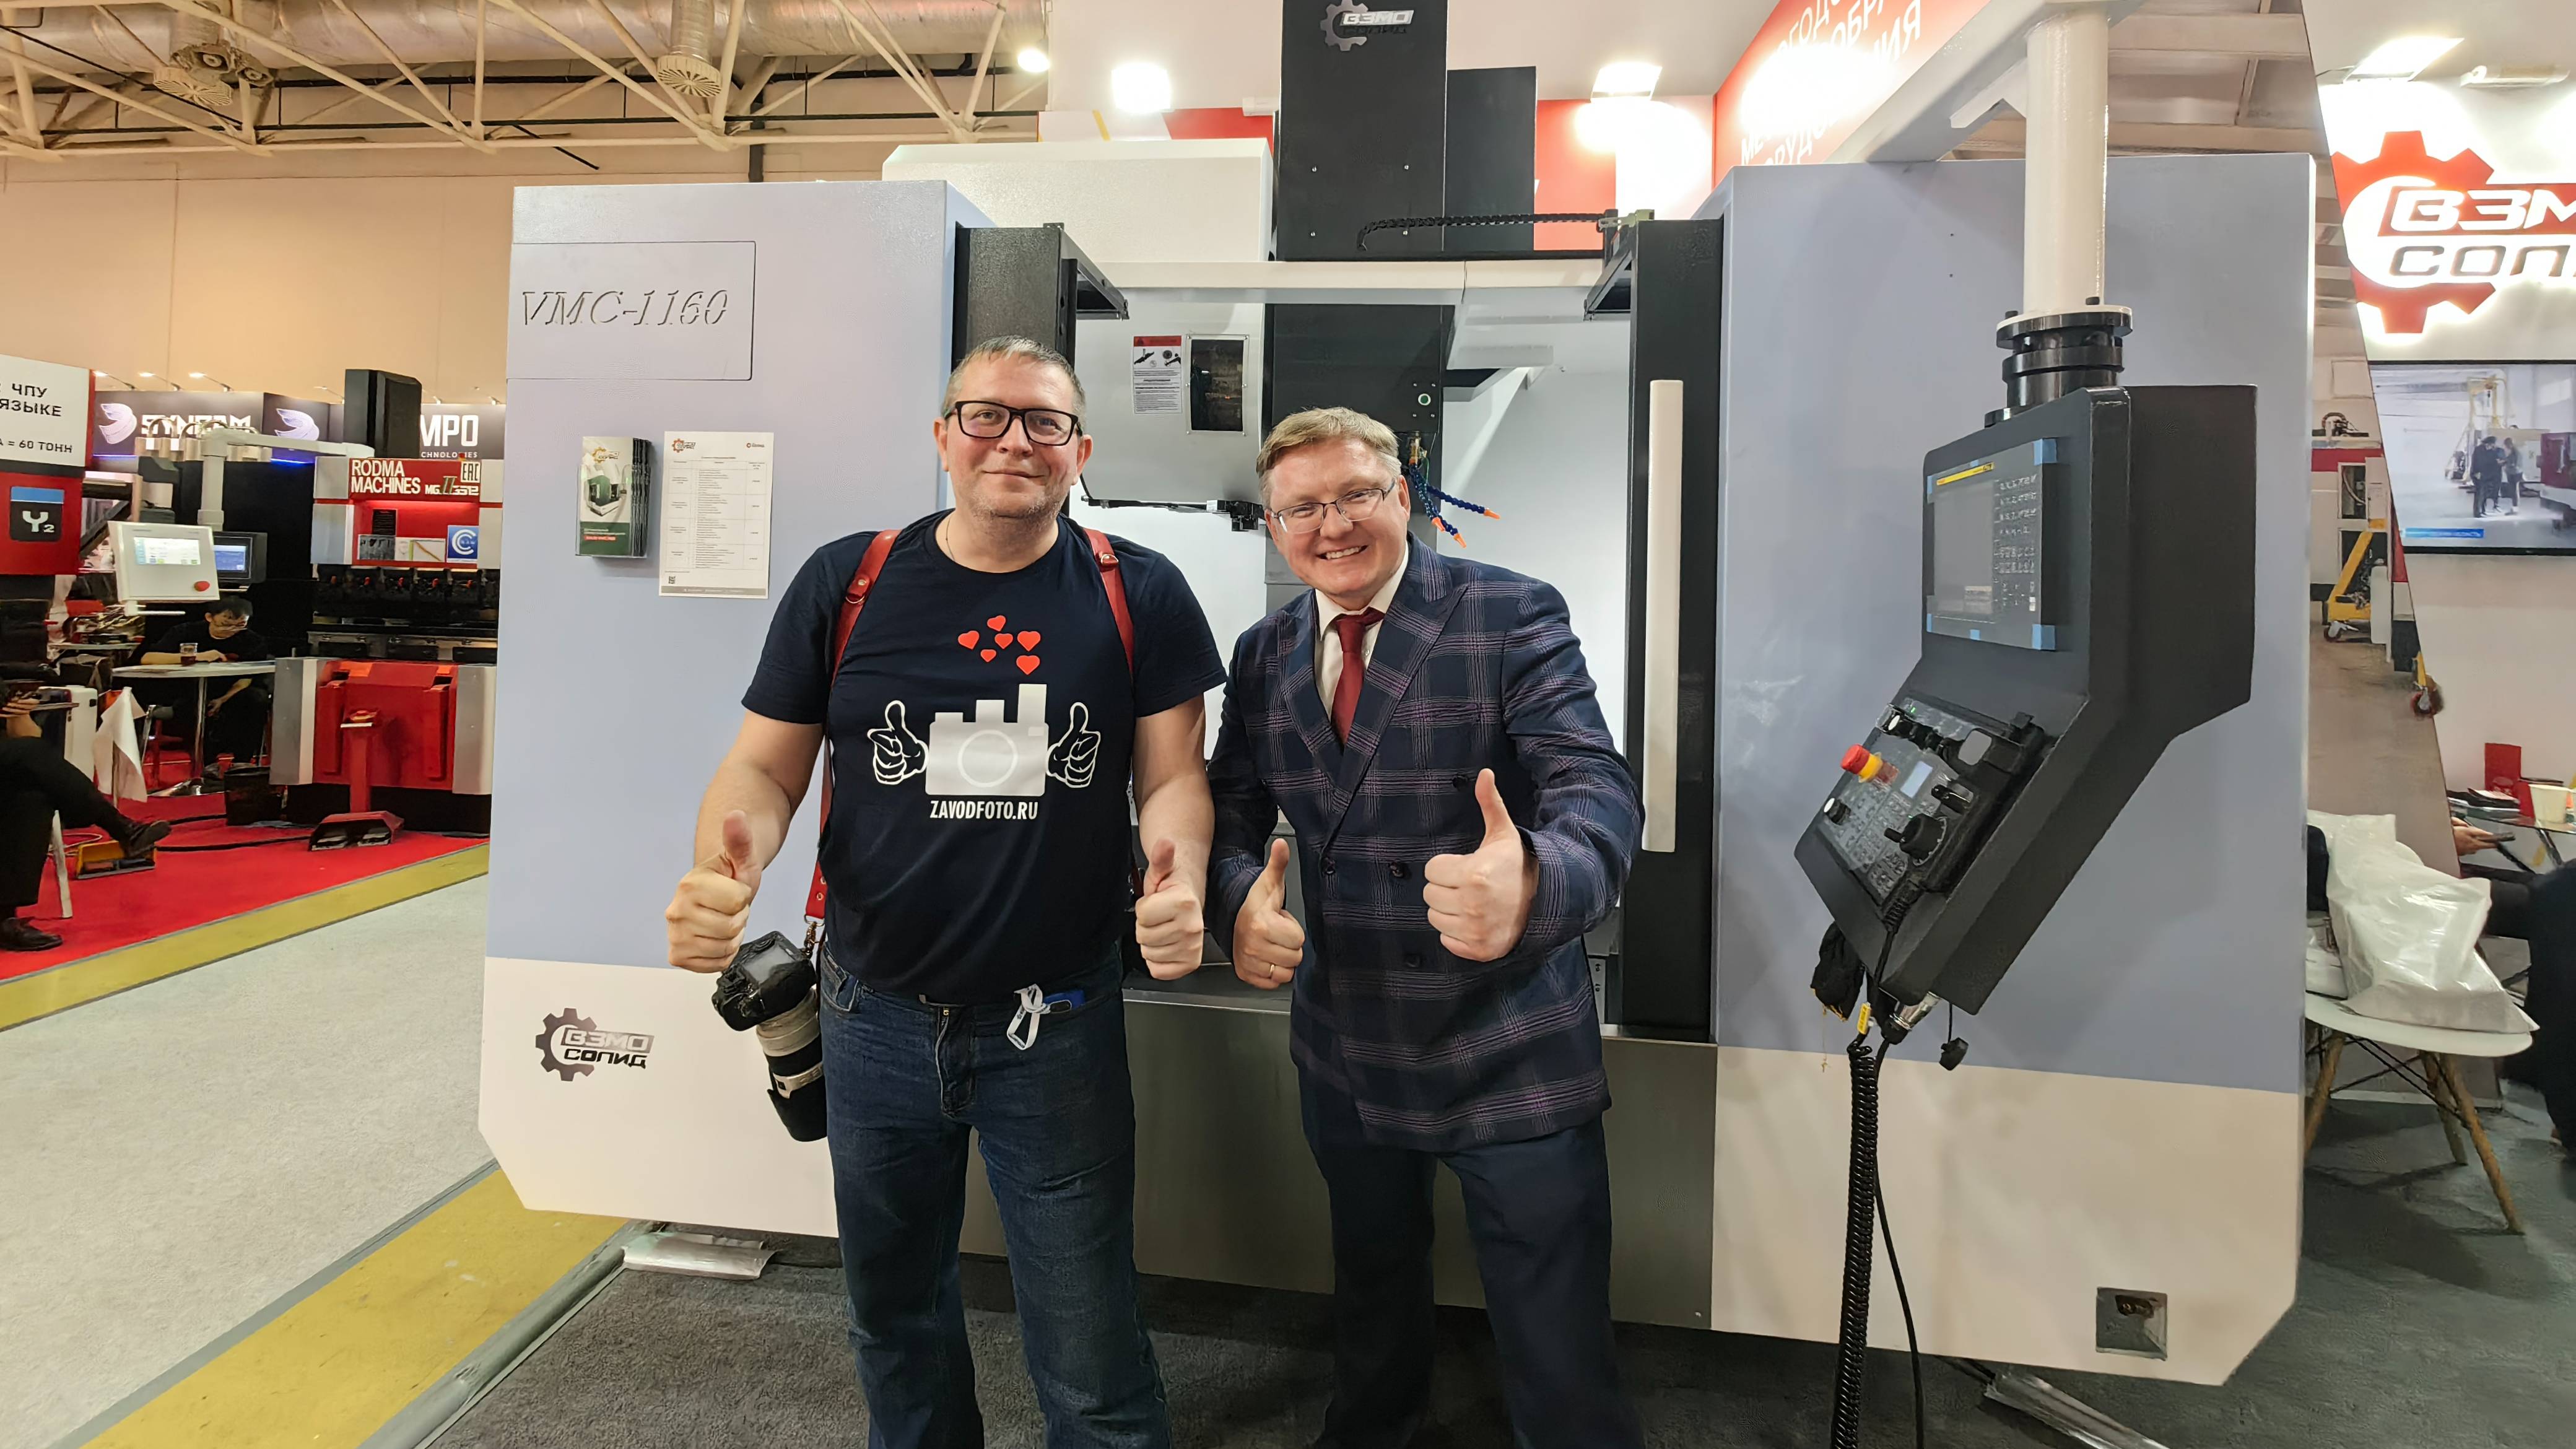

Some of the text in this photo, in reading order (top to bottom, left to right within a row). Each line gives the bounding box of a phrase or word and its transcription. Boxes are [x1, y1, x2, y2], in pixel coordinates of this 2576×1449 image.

[522, 289, 728, 326] VMC-1160
[11, 383, 48, 398] ЧПУ
[0, 398, 63, 417] ЯЗЫКЕ
[19, 440, 34, 450] 60
[37, 442, 73, 453] ТОНН
[420, 451, 478, 459] CHNOLOIES
[351, 459, 405, 477] RODMA
[350, 476, 421, 494] MACHINES
[929, 800, 1038, 820] ZAVODFOTO.RU
[564, 1029, 650, 1051] ВЗМО
[564, 1048, 648, 1069] СОЛИД
